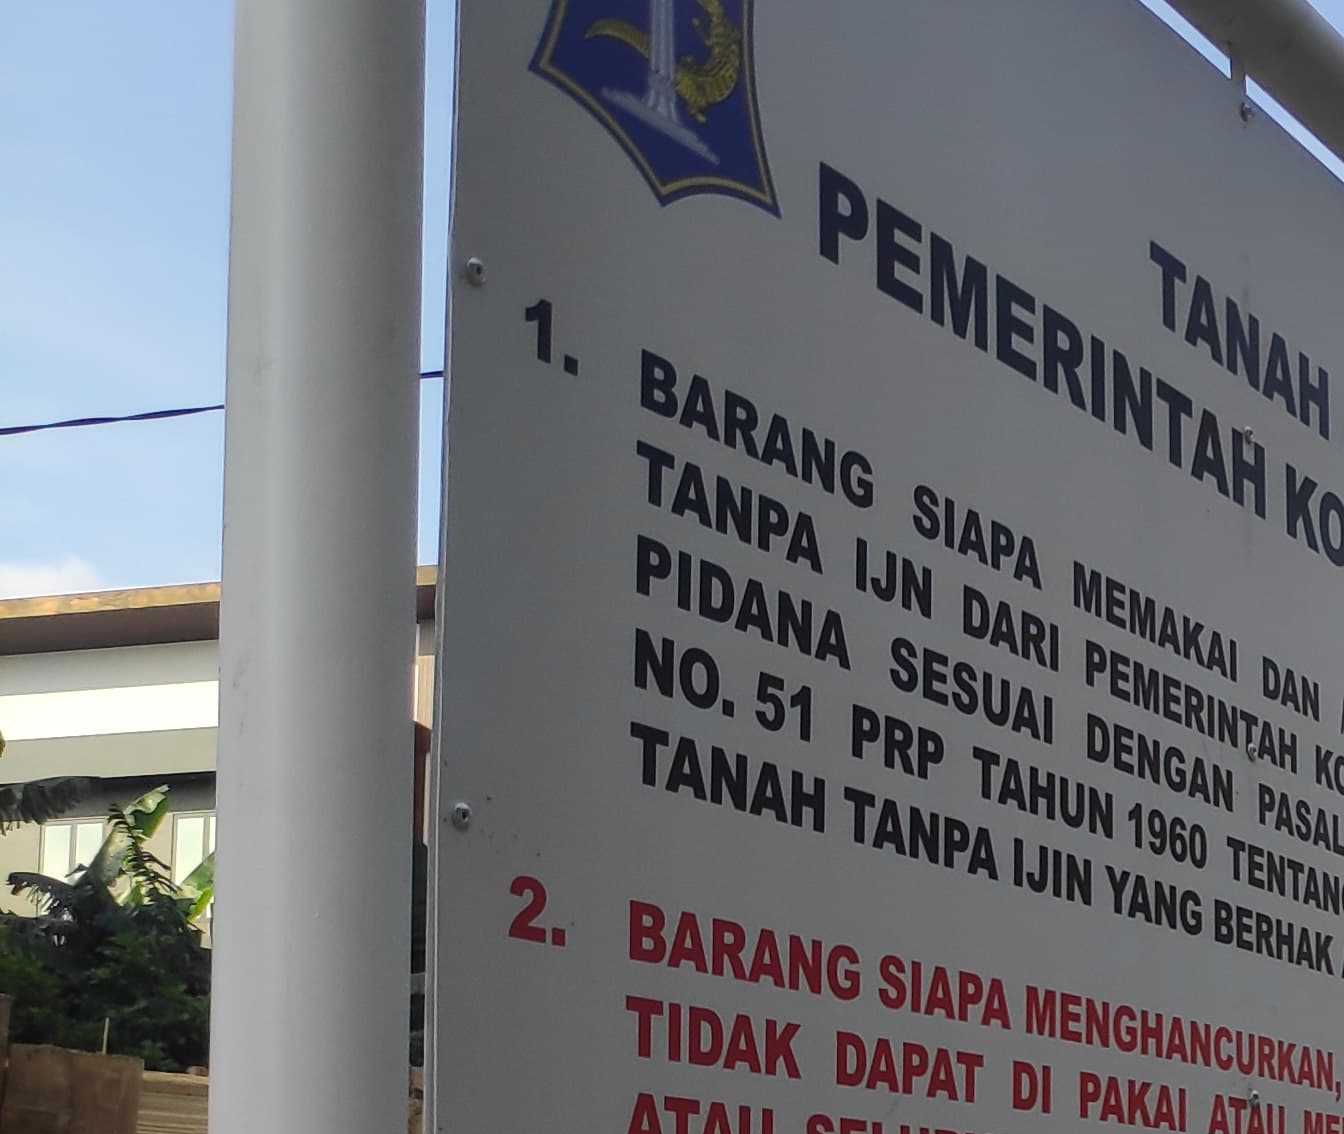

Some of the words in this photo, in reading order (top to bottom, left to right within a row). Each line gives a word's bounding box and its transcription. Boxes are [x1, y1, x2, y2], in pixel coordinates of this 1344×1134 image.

[818, 161, 1266, 521] PEMERINTAH
[1149, 239, 1331, 441] TANAH
[524, 298, 579, 377] 1.
[640, 348, 874, 509] BARANG
[912, 484, 1043, 591] SIAPA
[1073, 559, 1238, 683] MEMAKAI
[1262, 655, 1320, 723] DAN
[636, 439, 824, 575] TANPA
[855, 536, 932, 620] IJN
[962, 583, 1059, 673] DARI
[1085, 639, 1298, 775] PEMERINTAH
[634, 627, 735, 719] NO.
[754, 671, 812, 743] 51
[851, 703, 945, 781] PRP
[972, 745, 1114, 840] TAHUN
[1127, 802, 1208, 870] 1960
[636, 533, 851, 672] PIDANA
[889, 637, 1053, 745] SESUAI
[1086, 712, 1234, 813] DENGAN
[629, 720, 826, 834] TANAH
[843, 785, 999, 881] TANPA
[1013, 837, 1092, 907] IJIN
[1104, 864, 1203, 936] YANG
[1213, 898, 1335, 976] BERHAK
[507, 875, 566, 947] 2.
[628, 899, 861, 1001] BARANG
[877, 954, 1012, 1031] SIAPA
[1025, 984, 1342, 1102] MENGHANCURKAN,
[625, 994, 802, 1080] TIDAK
[835, 1030, 985, 1104] DAPAT
[1012, 1059, 1052, 1115] DI
[1079, 1071, 1187, 1133] PAKAI
